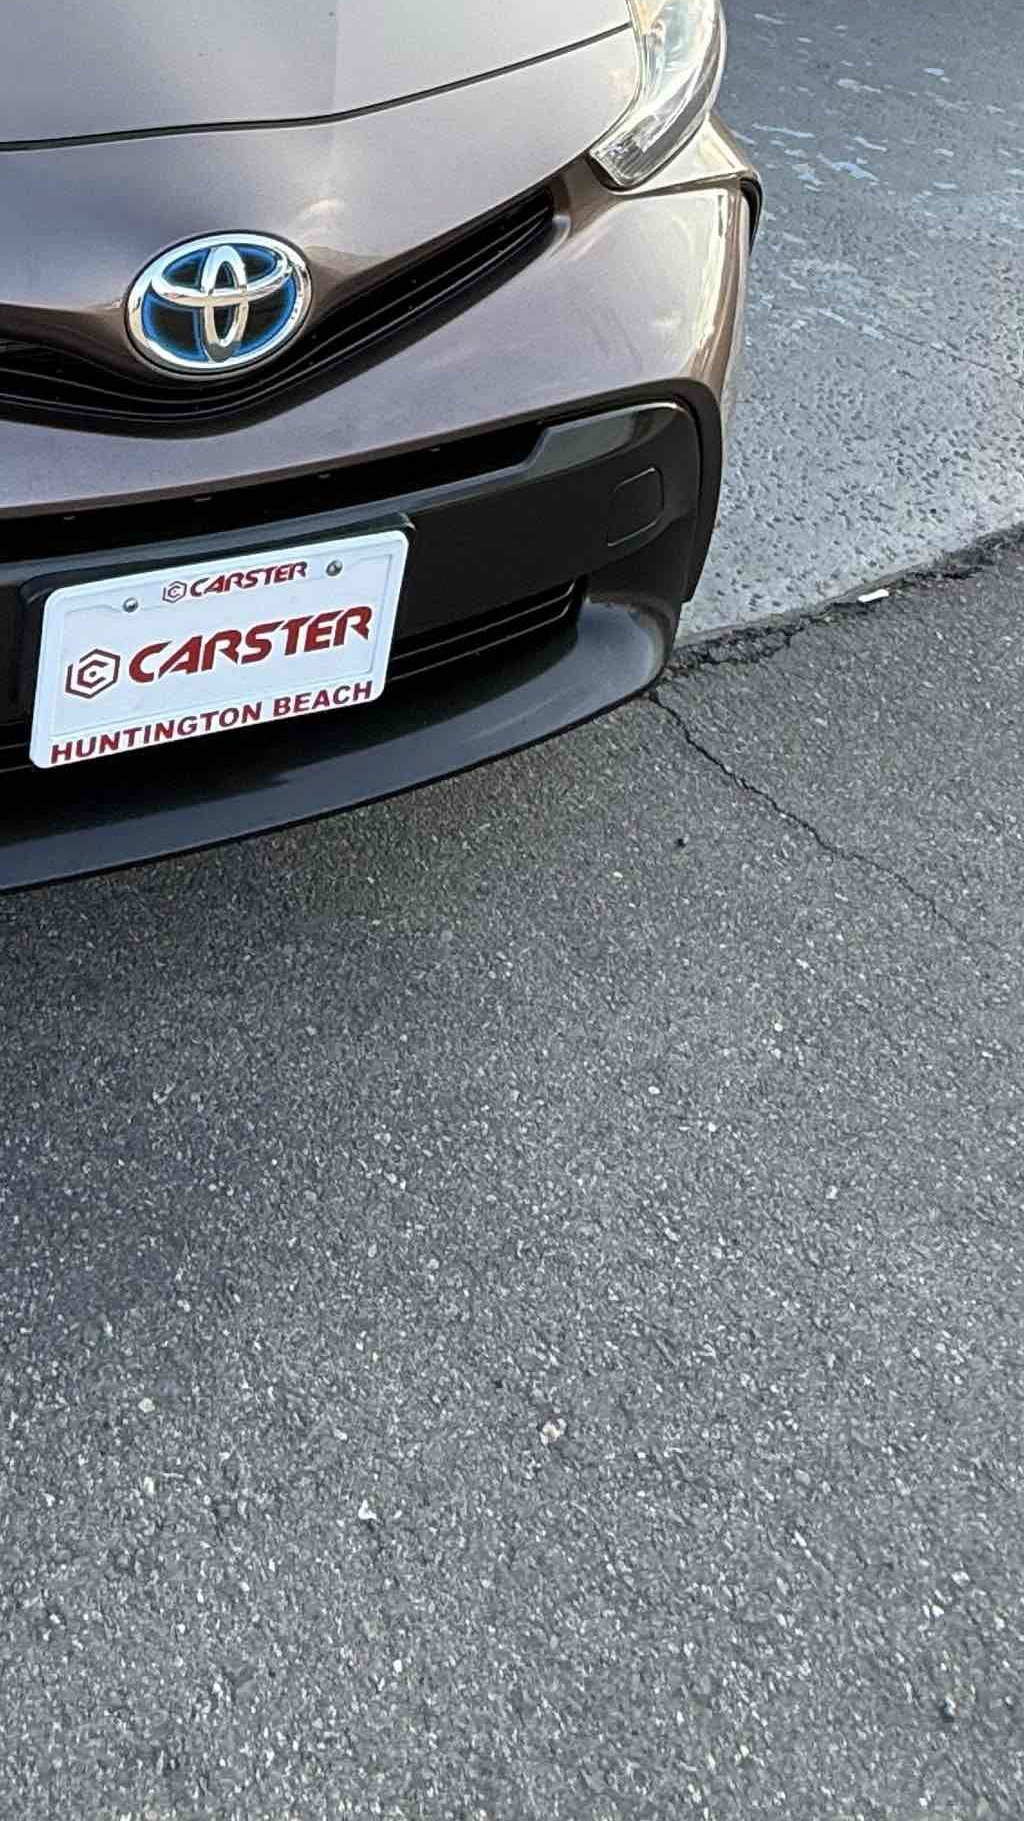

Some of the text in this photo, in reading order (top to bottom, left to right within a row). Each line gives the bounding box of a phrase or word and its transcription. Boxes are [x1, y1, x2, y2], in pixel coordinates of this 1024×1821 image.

[189, 560, 309, 598] CARSTER
[128, 605, 373, 683] CARSTER
[50, 680, 373, 764] HUNTINGTON BEACH
